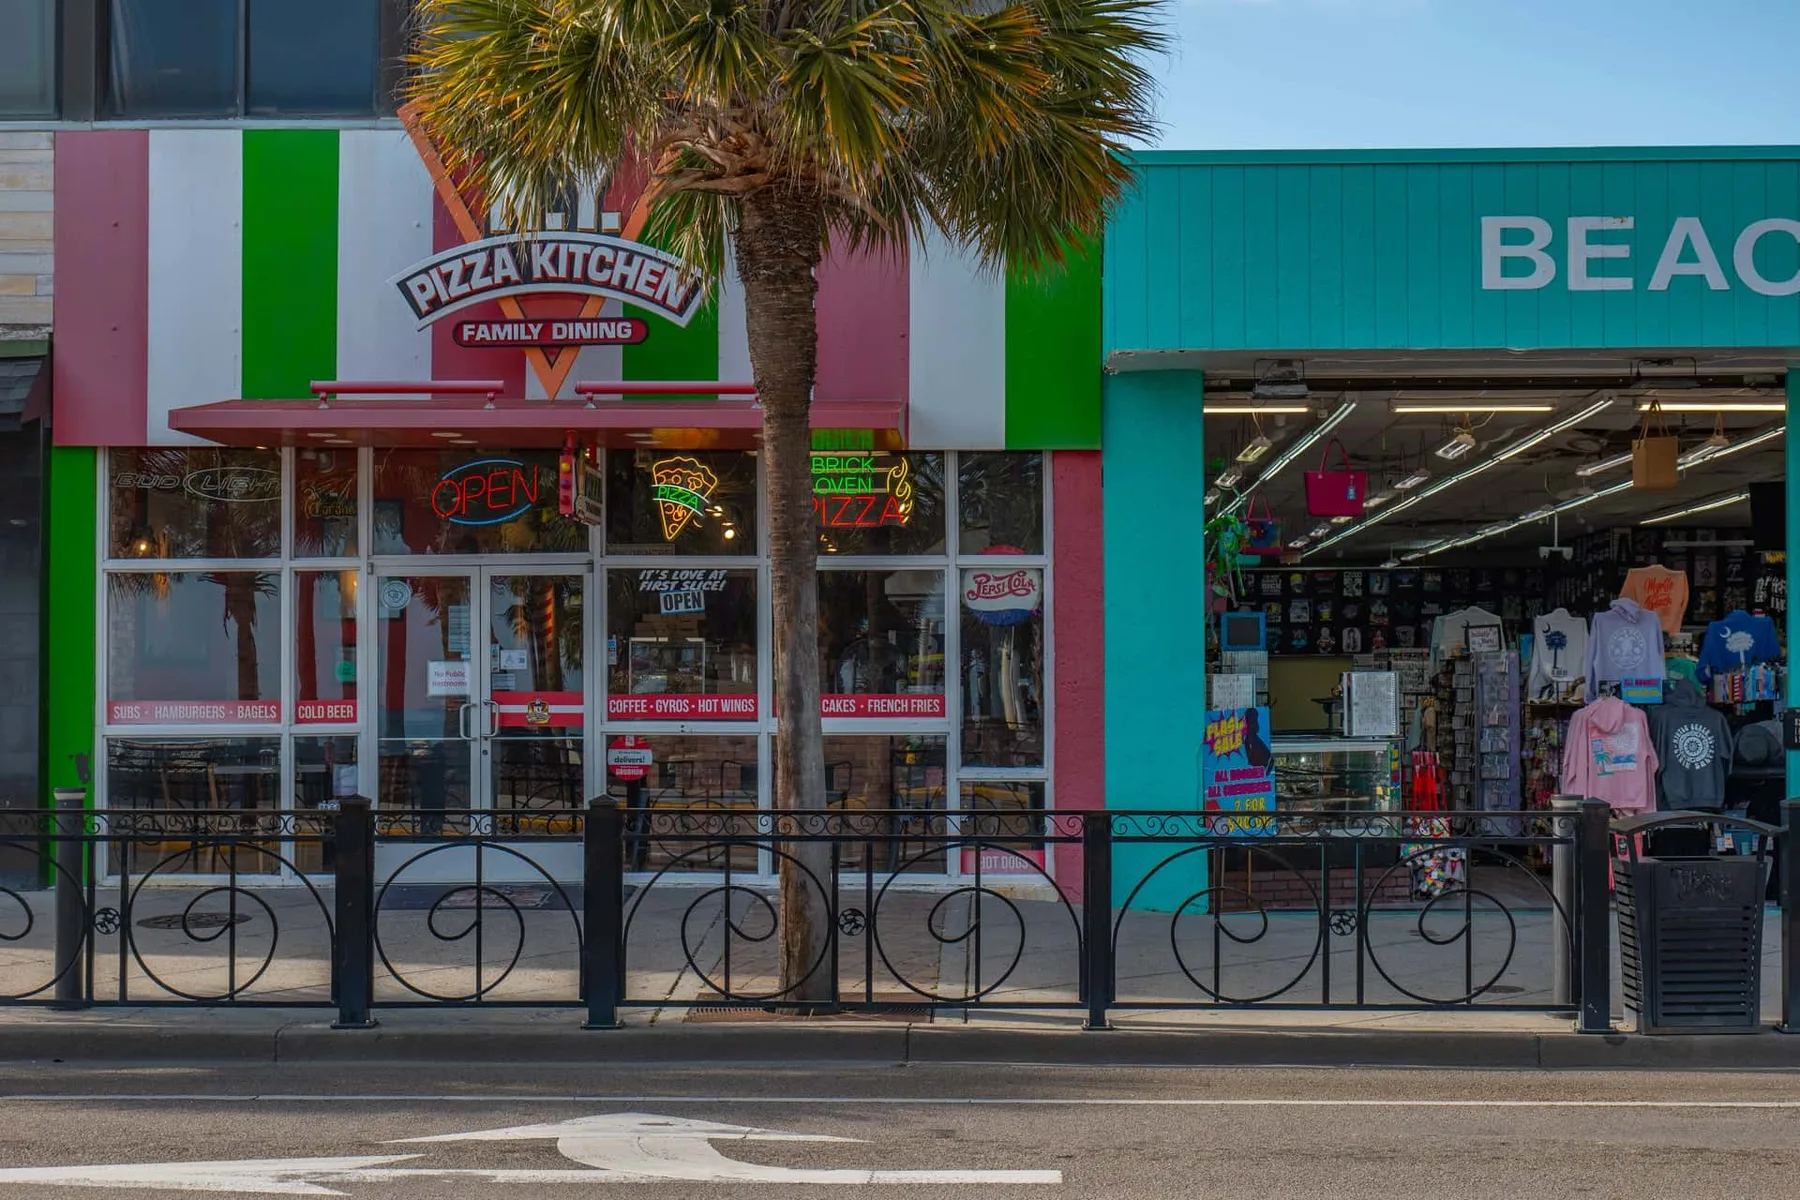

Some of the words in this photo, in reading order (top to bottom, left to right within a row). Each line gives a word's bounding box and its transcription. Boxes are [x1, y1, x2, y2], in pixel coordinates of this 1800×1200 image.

[407, 246, 522, 314] PIZZA
[530, 242, 692, 313] KITCHEN
[462, 321, 543, 341] FAMILY
[551, 320, 632, 341] DINING
[811, 456, 875, 475] BRICK
[114, 472, 181, 489] BUD
[815, 477, 872, 495] OVEN
[431, 463, 539, 519] OPEN
[658, 485, 699, 510] PIZZA
[639, 569, 668, 580] IT'S
[672, 569, 705, 580] LOVE
[708, 569, 728, 580] AT
[639, 581, 677, 592] FIRST
[681, 580, 727, 592] SLICE!
[663, 592, 702, 611] OPEN
[113, 705, 140, 720] SUBS
[155, 705, 226, 720] HAMBURGERS
[237, 705, 277, 719] BAGELS
[299, 705, 324, 719] COLD
[327, 705, 354, 719] BEER
[609, 699, 647, 713] COFFEE
[655, 699, 690, 713] GYROS
[698, 699, 719, 712] HOT
[720, 698, 755, 712] WINGS
[822, 698, 856, 713] CAKES
[867, 698, 908, 713] FRENCH
[910, 698, 940, 713] FRIES
[614, 755, 645, 764] delivers!
[1245, 797, 1266, 811] FOR
